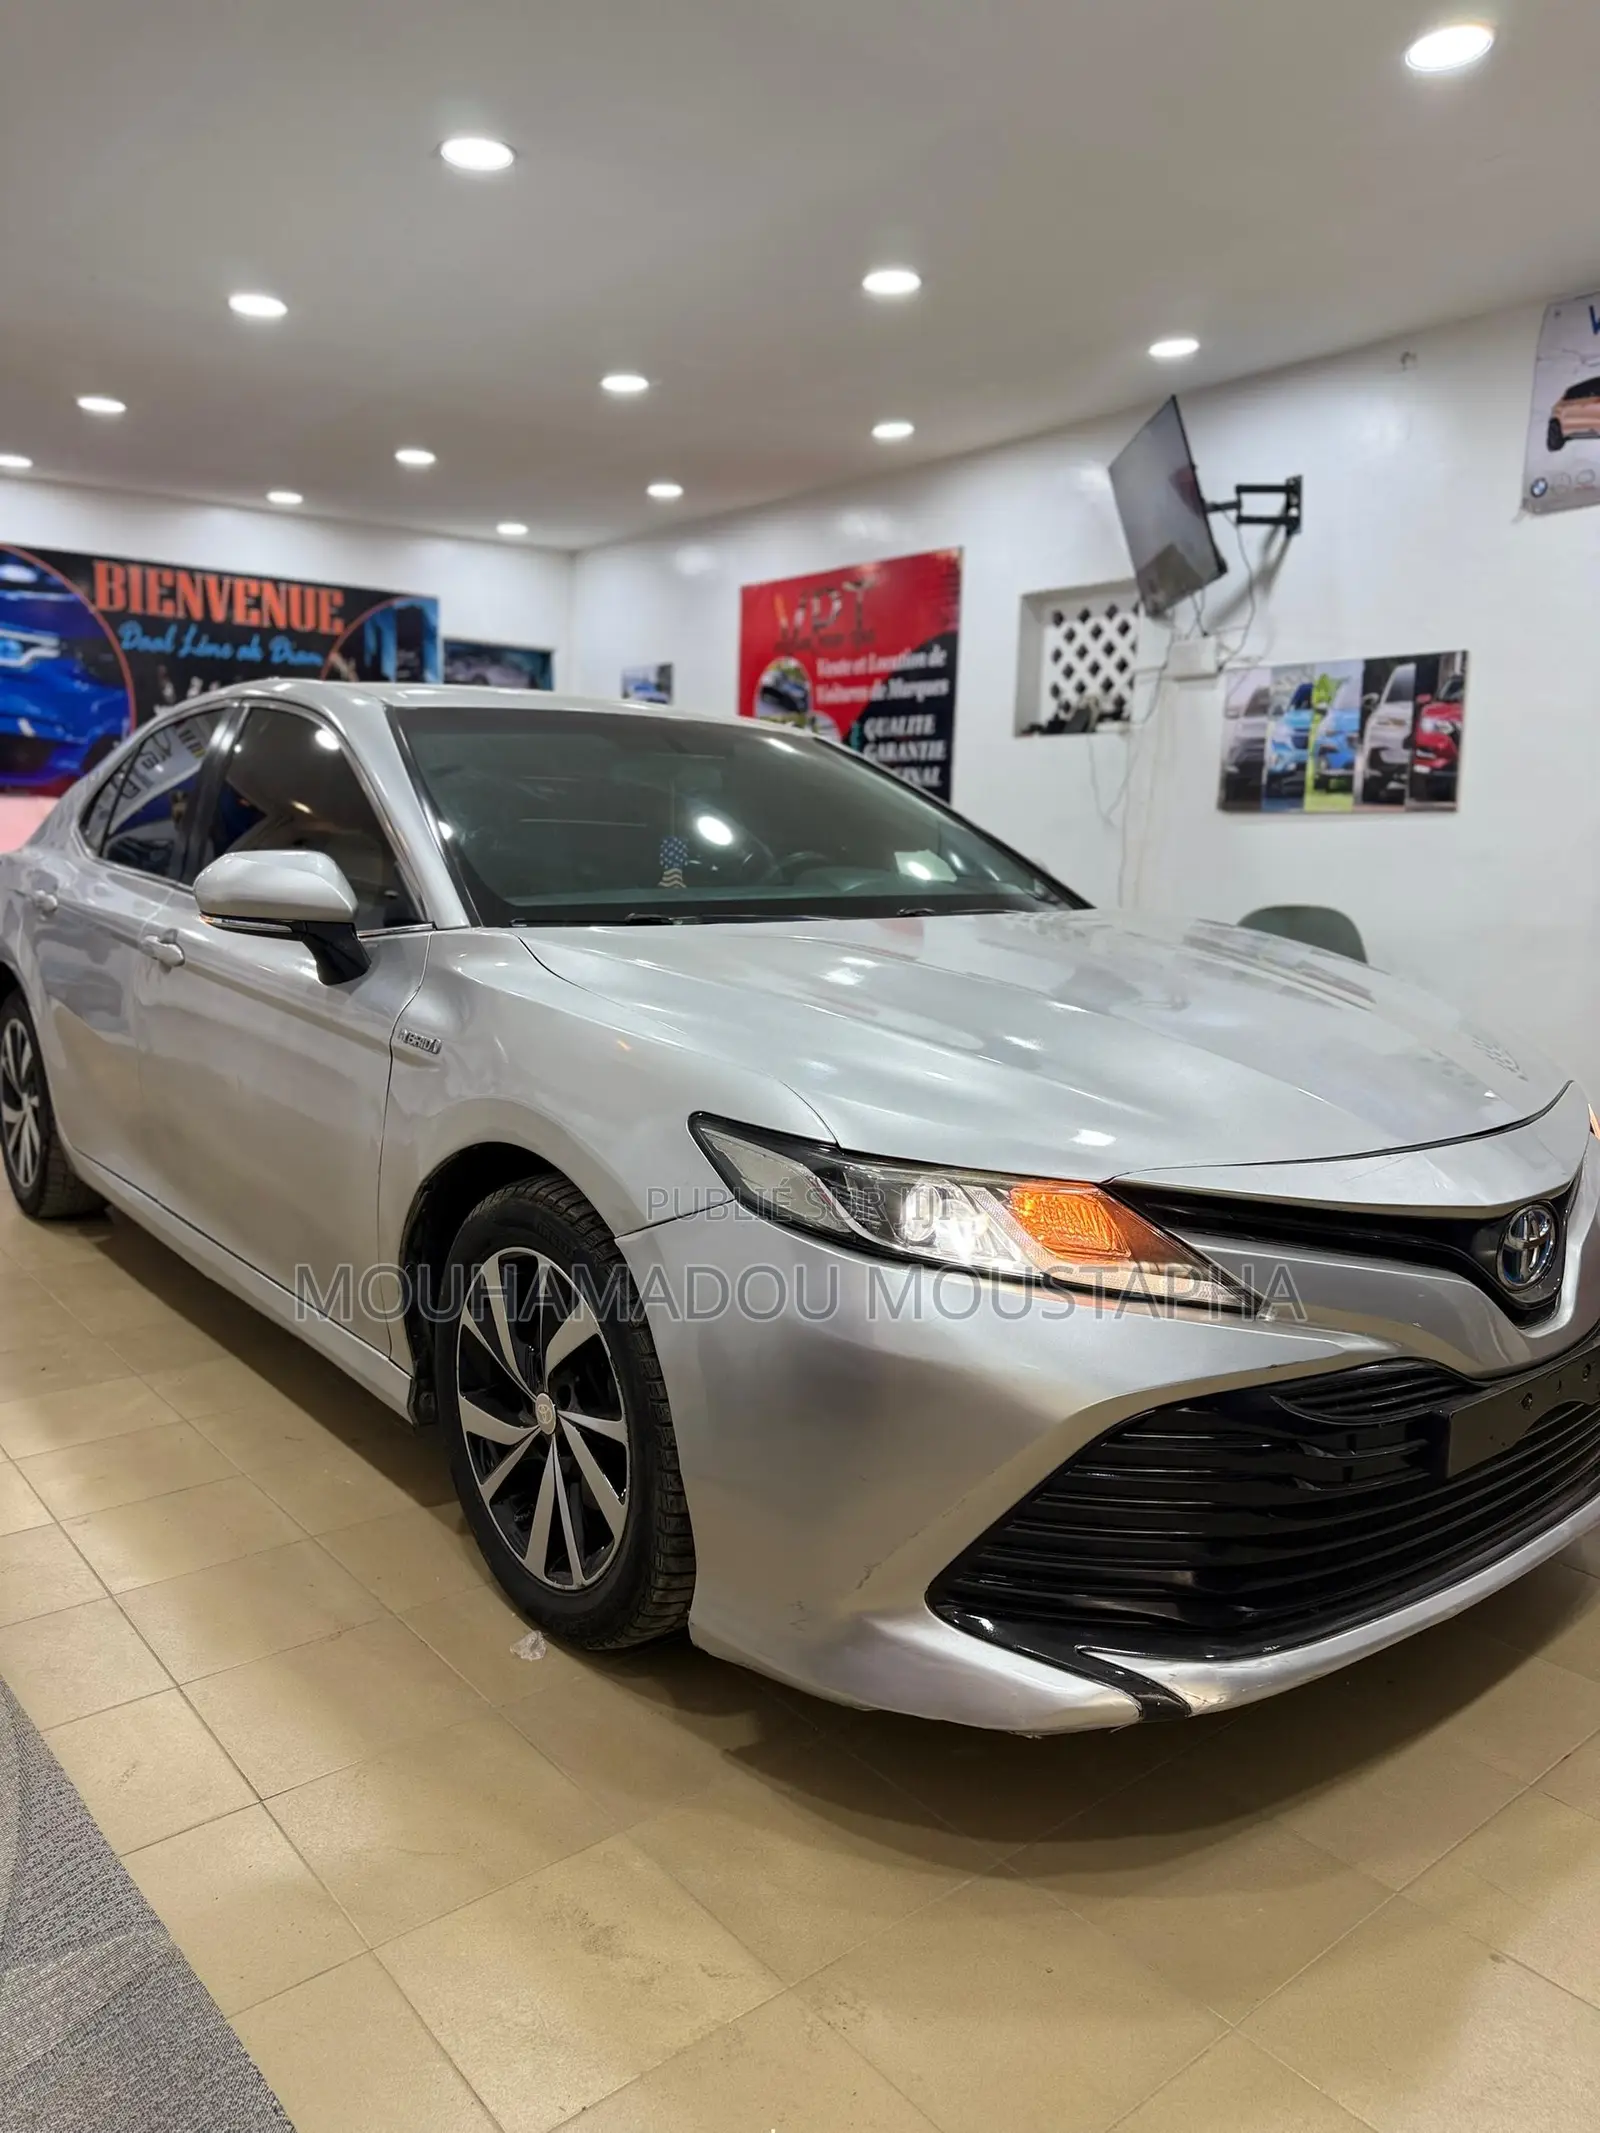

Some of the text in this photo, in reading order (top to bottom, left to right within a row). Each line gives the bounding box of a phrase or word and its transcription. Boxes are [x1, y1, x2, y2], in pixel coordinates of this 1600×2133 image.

[93, 559, 346, 635] BIENVENUE
[868, 648, 927, 673] Location
[928, 644, 948, 667] de
